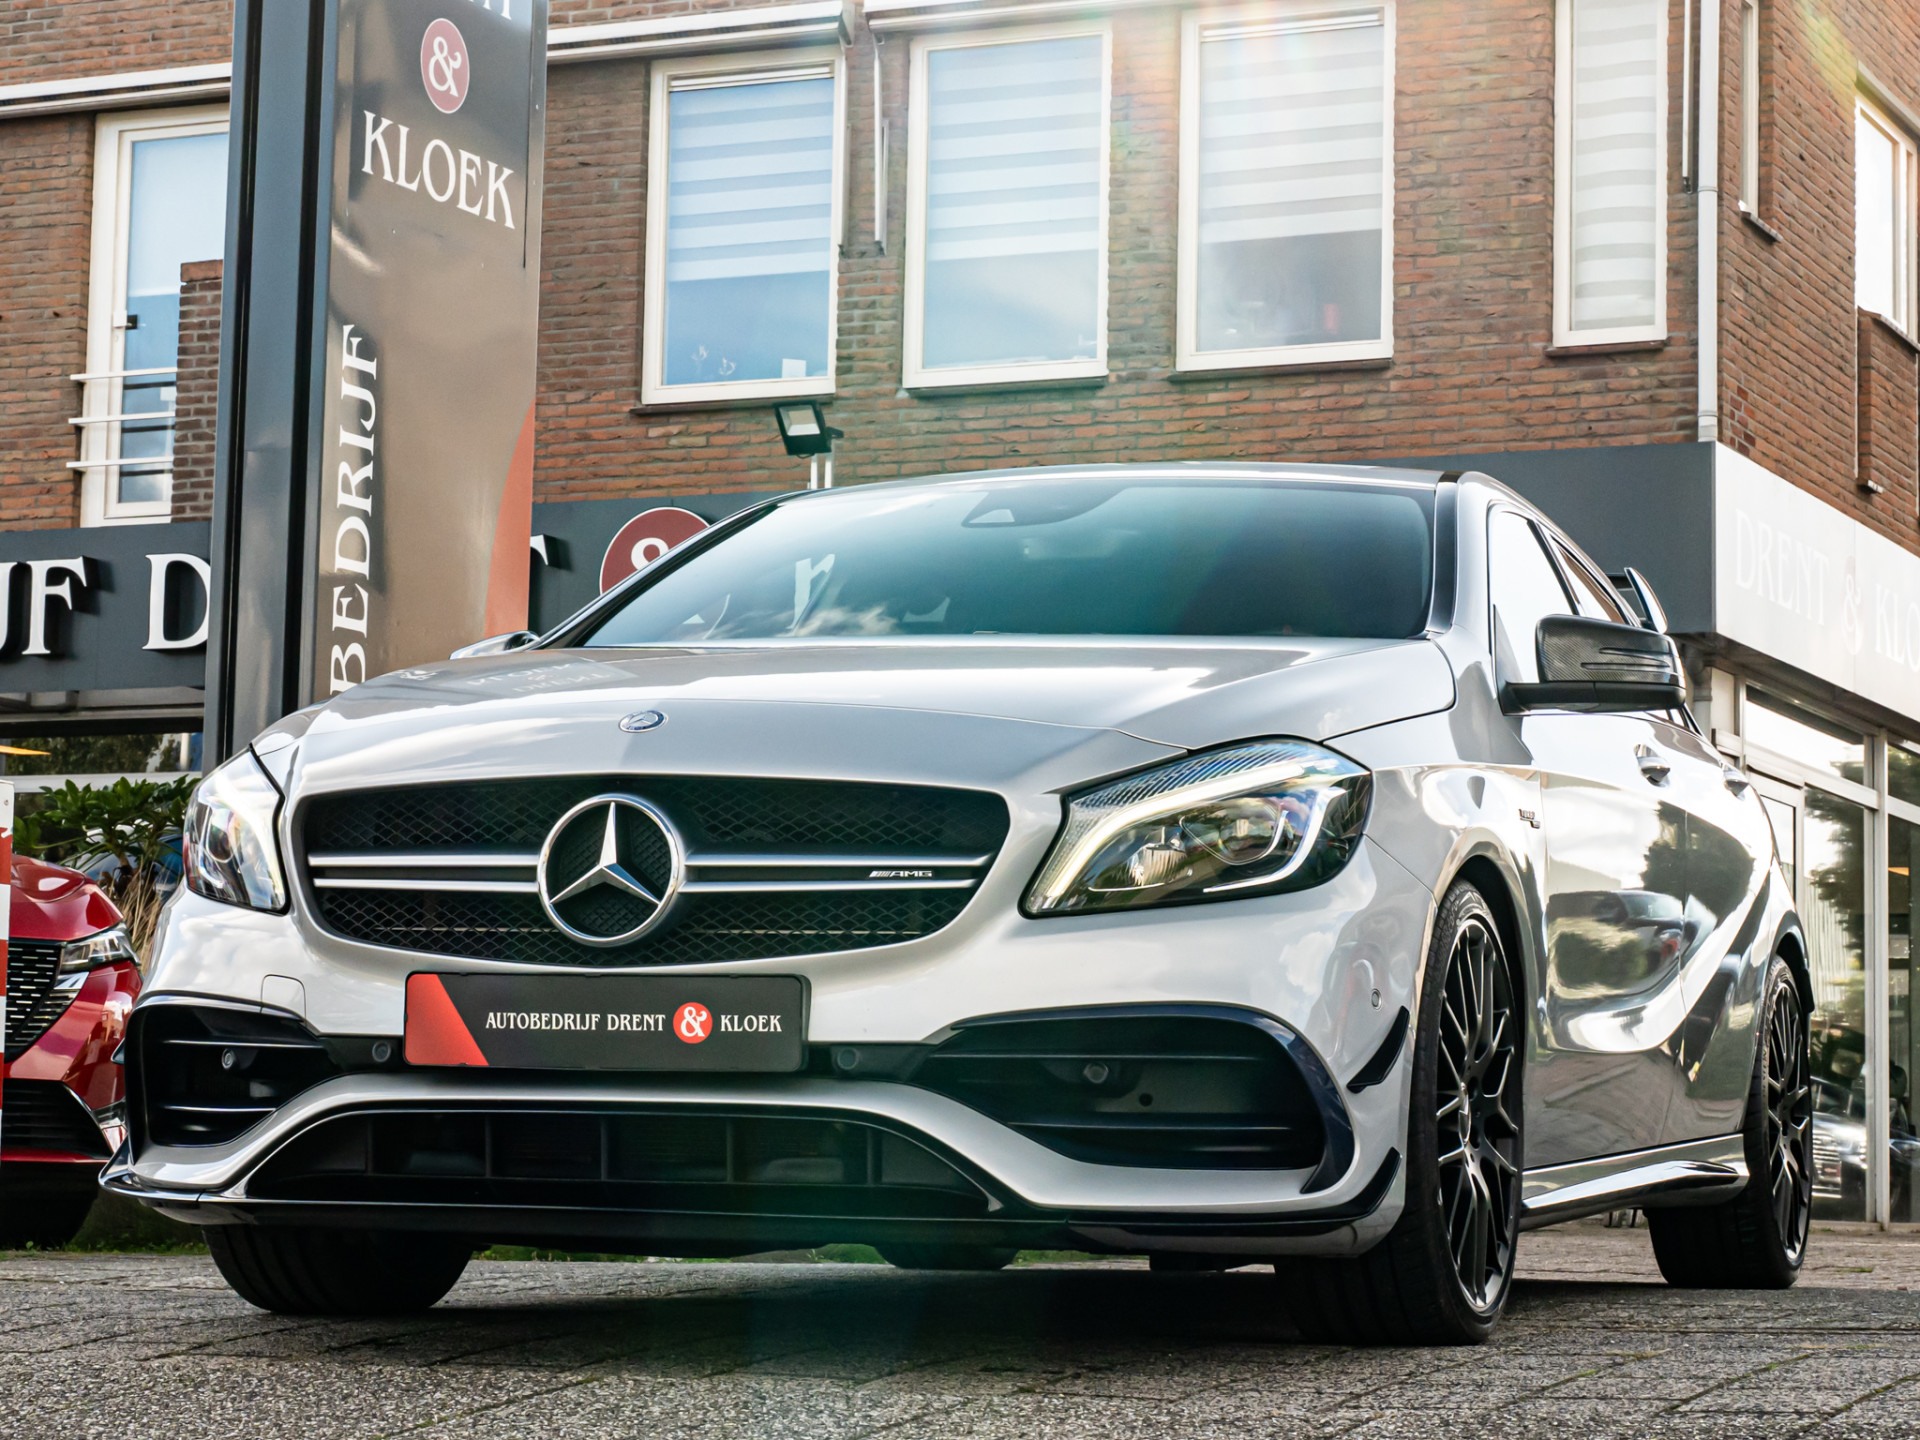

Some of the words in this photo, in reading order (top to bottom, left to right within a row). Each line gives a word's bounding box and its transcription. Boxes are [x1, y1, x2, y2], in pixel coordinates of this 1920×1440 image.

[429, 36, 462, 98] &
[361, 109, 516, 230] KLOEK
[1735, 507, 1830, 627] DRENT
[485, 1011, 601, 1031] AUTOBEDRIJF
[606, 1013, 666, 1032] DRENT
[680, 1006, 707, 1037] &
[720, 1014, 783, 1032] KLOEK
